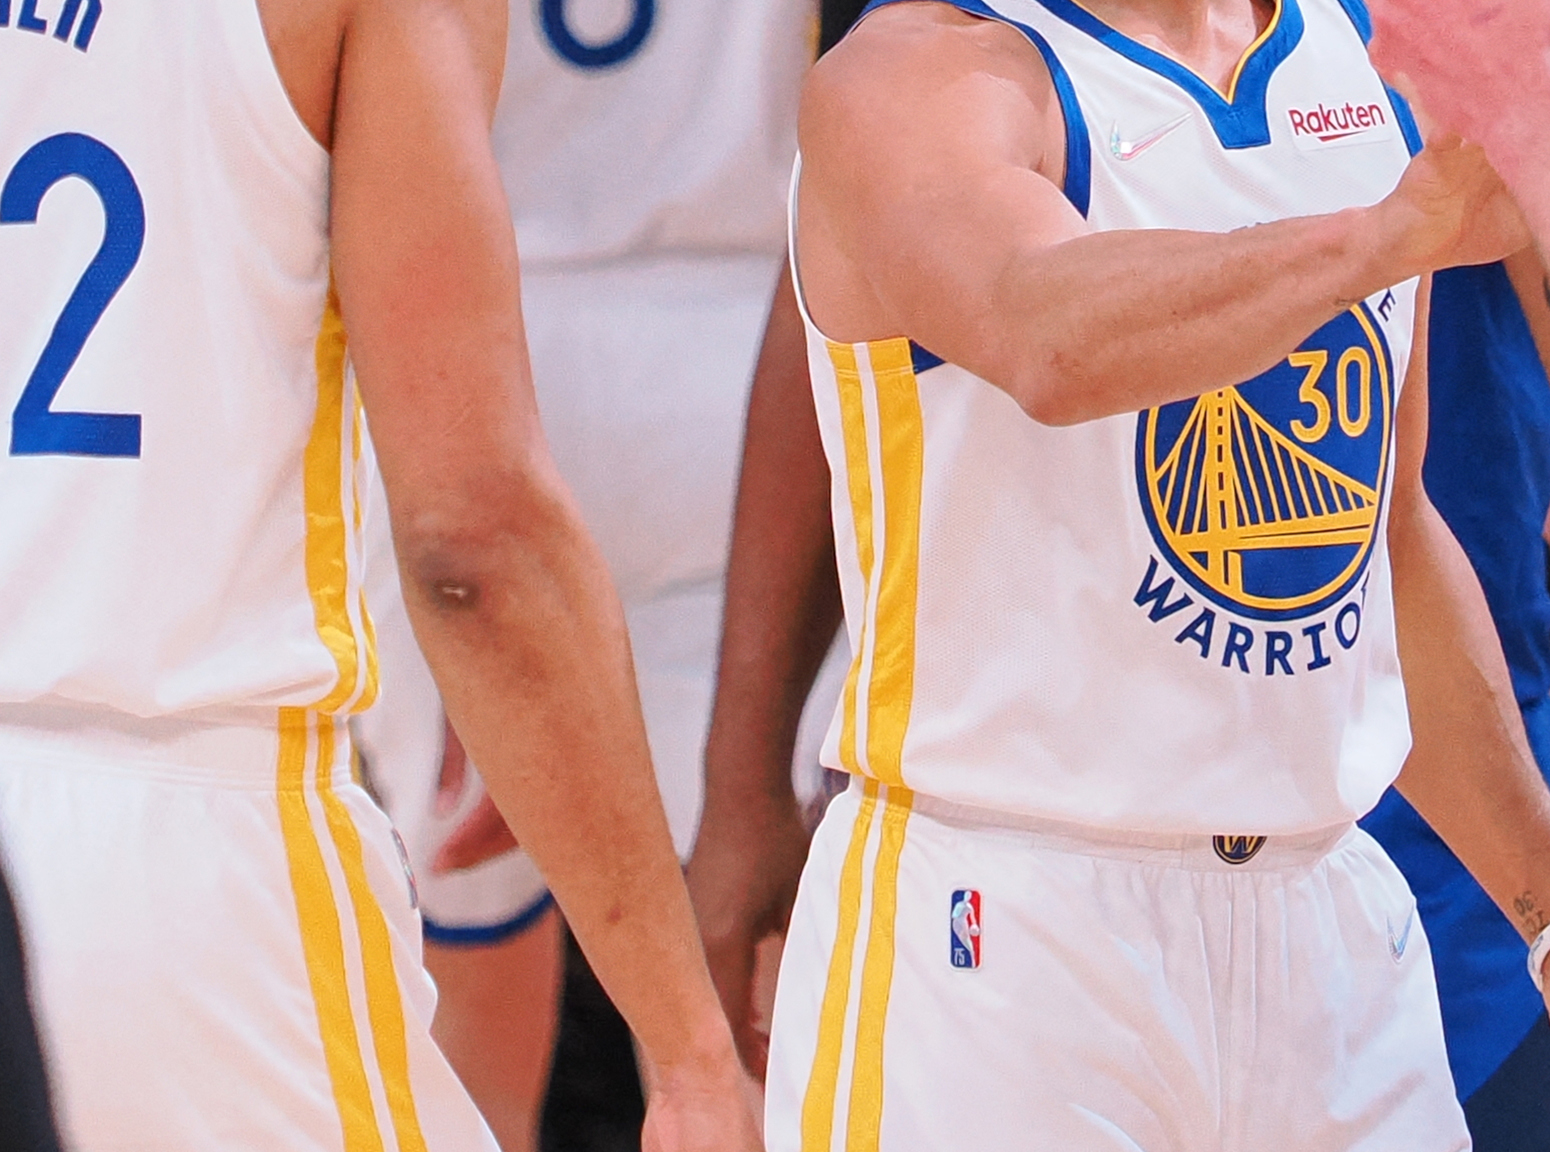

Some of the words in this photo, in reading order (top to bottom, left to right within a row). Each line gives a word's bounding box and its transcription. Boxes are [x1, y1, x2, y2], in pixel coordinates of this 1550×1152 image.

[1287, 102, 1386, 137] Rakuten
[0, 131, 146, 458] 2
[1288, 346, 1371, 443] 30
[1133, 554, 1370, 676] WARRIO
